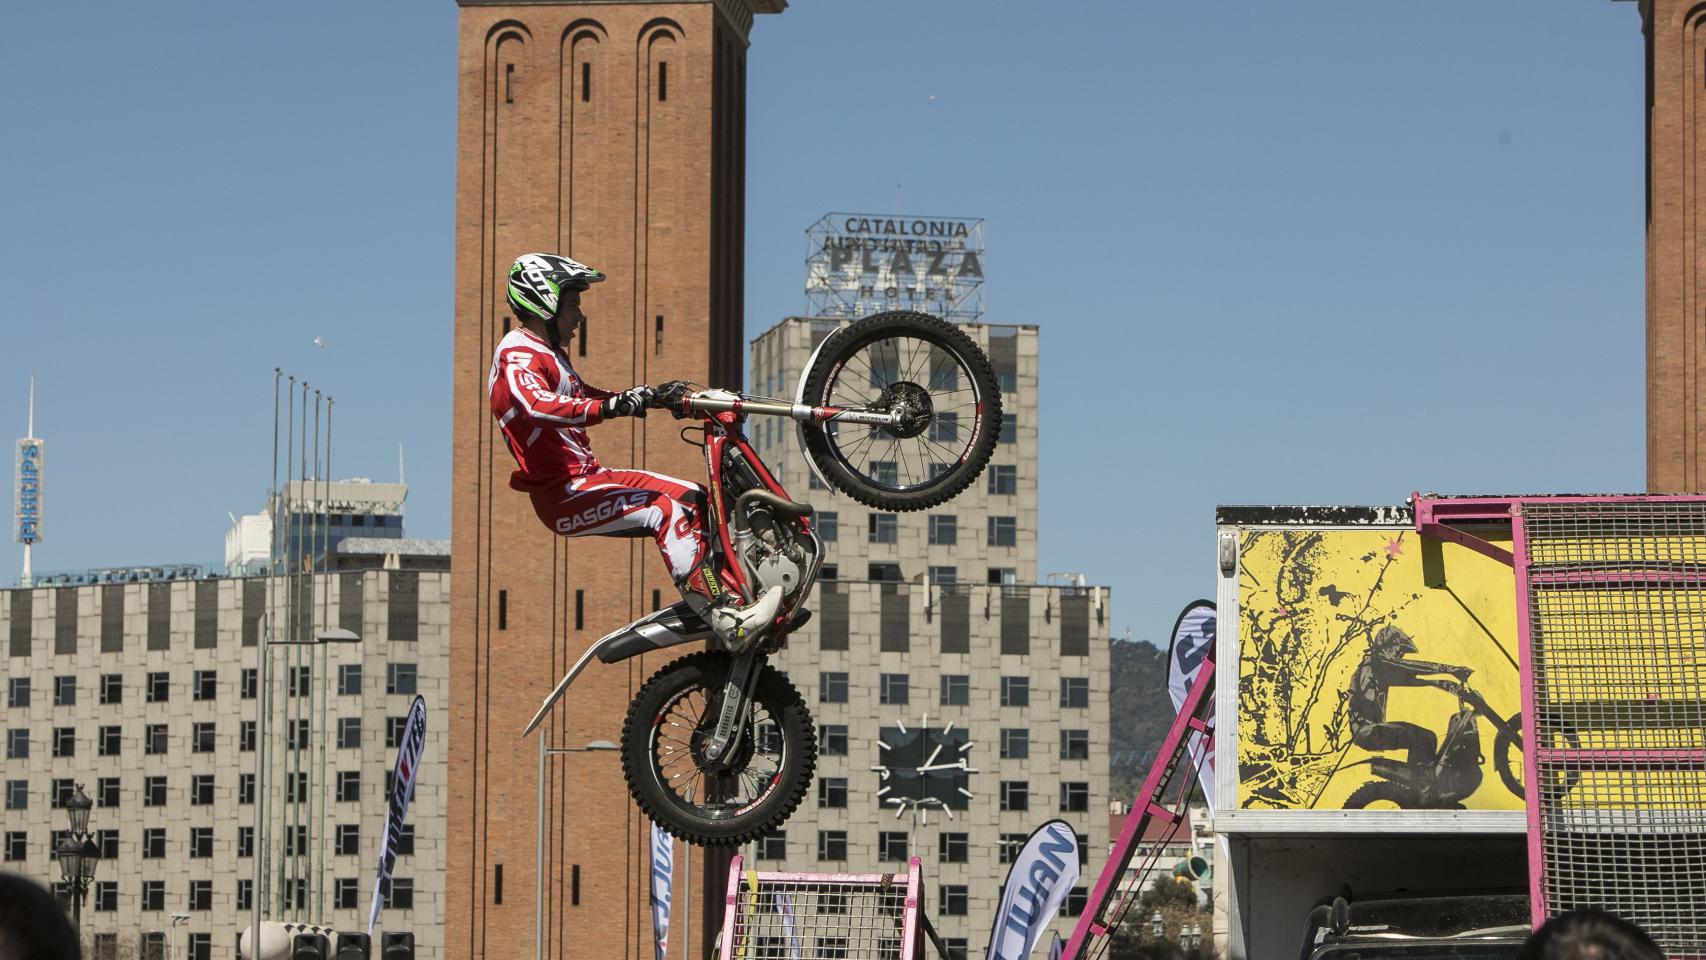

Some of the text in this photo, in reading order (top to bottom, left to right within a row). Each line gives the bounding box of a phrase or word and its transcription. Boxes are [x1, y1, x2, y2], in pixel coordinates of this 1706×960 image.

[845, 217, 968, 238] CATALONIA
[830, 248, 984, 277] PLAZA
[860, 285, 955, 300] HOTEL
[858, 414, 889, 423] MICHELIN
[20, 444, 38, 539] PHILIPS
[556, 491, 649, 533] GASGAS
